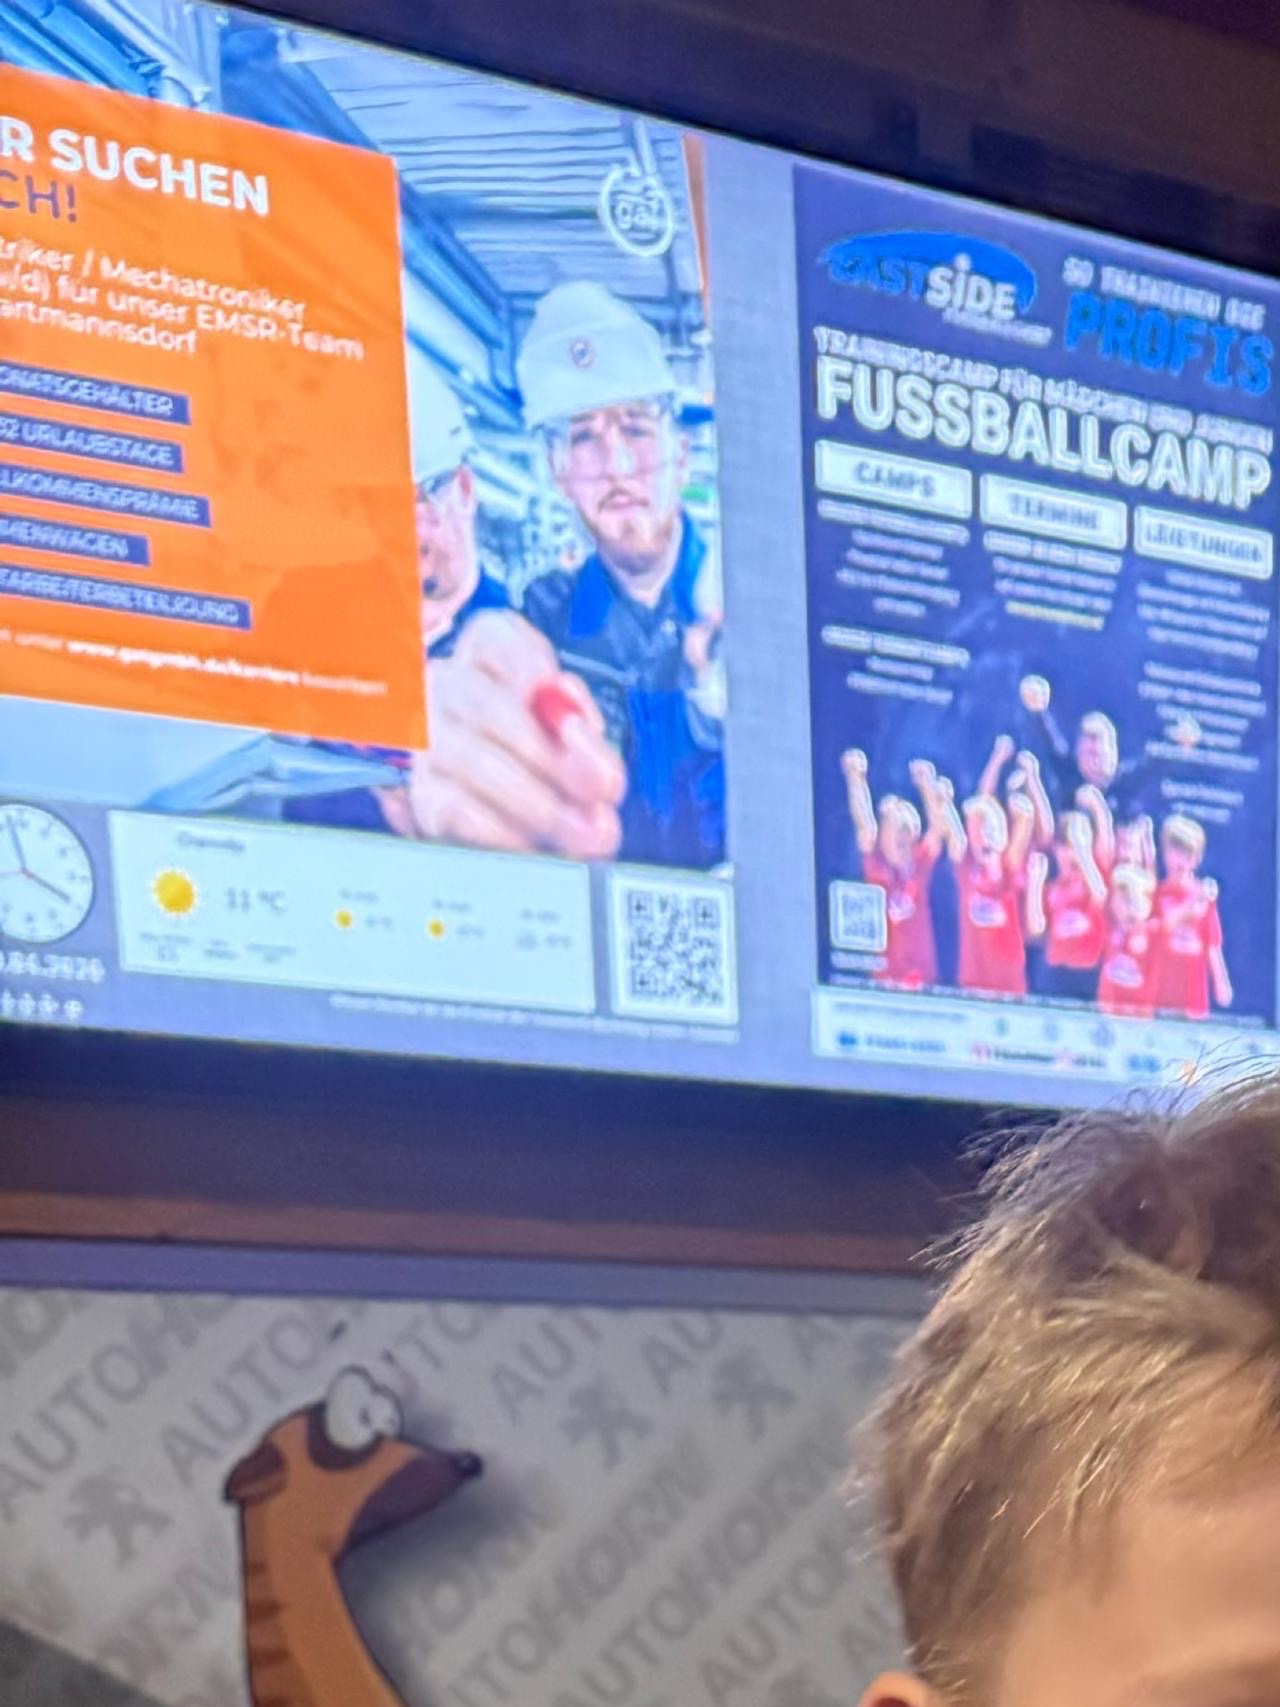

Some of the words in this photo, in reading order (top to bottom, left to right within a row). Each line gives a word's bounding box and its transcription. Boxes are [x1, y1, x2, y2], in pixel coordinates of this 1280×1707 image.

[49, 129, 270, 216] SUCHEN
[107, 291, 189, 324] unser
[196, 304, 364, 360] EMSR-Team
[1064, 289, 1274, 397] PROFIS
[817, 355, 1272, 511] FUSSBALLCAMP
[853, 461, 936, 498] CAMPS
